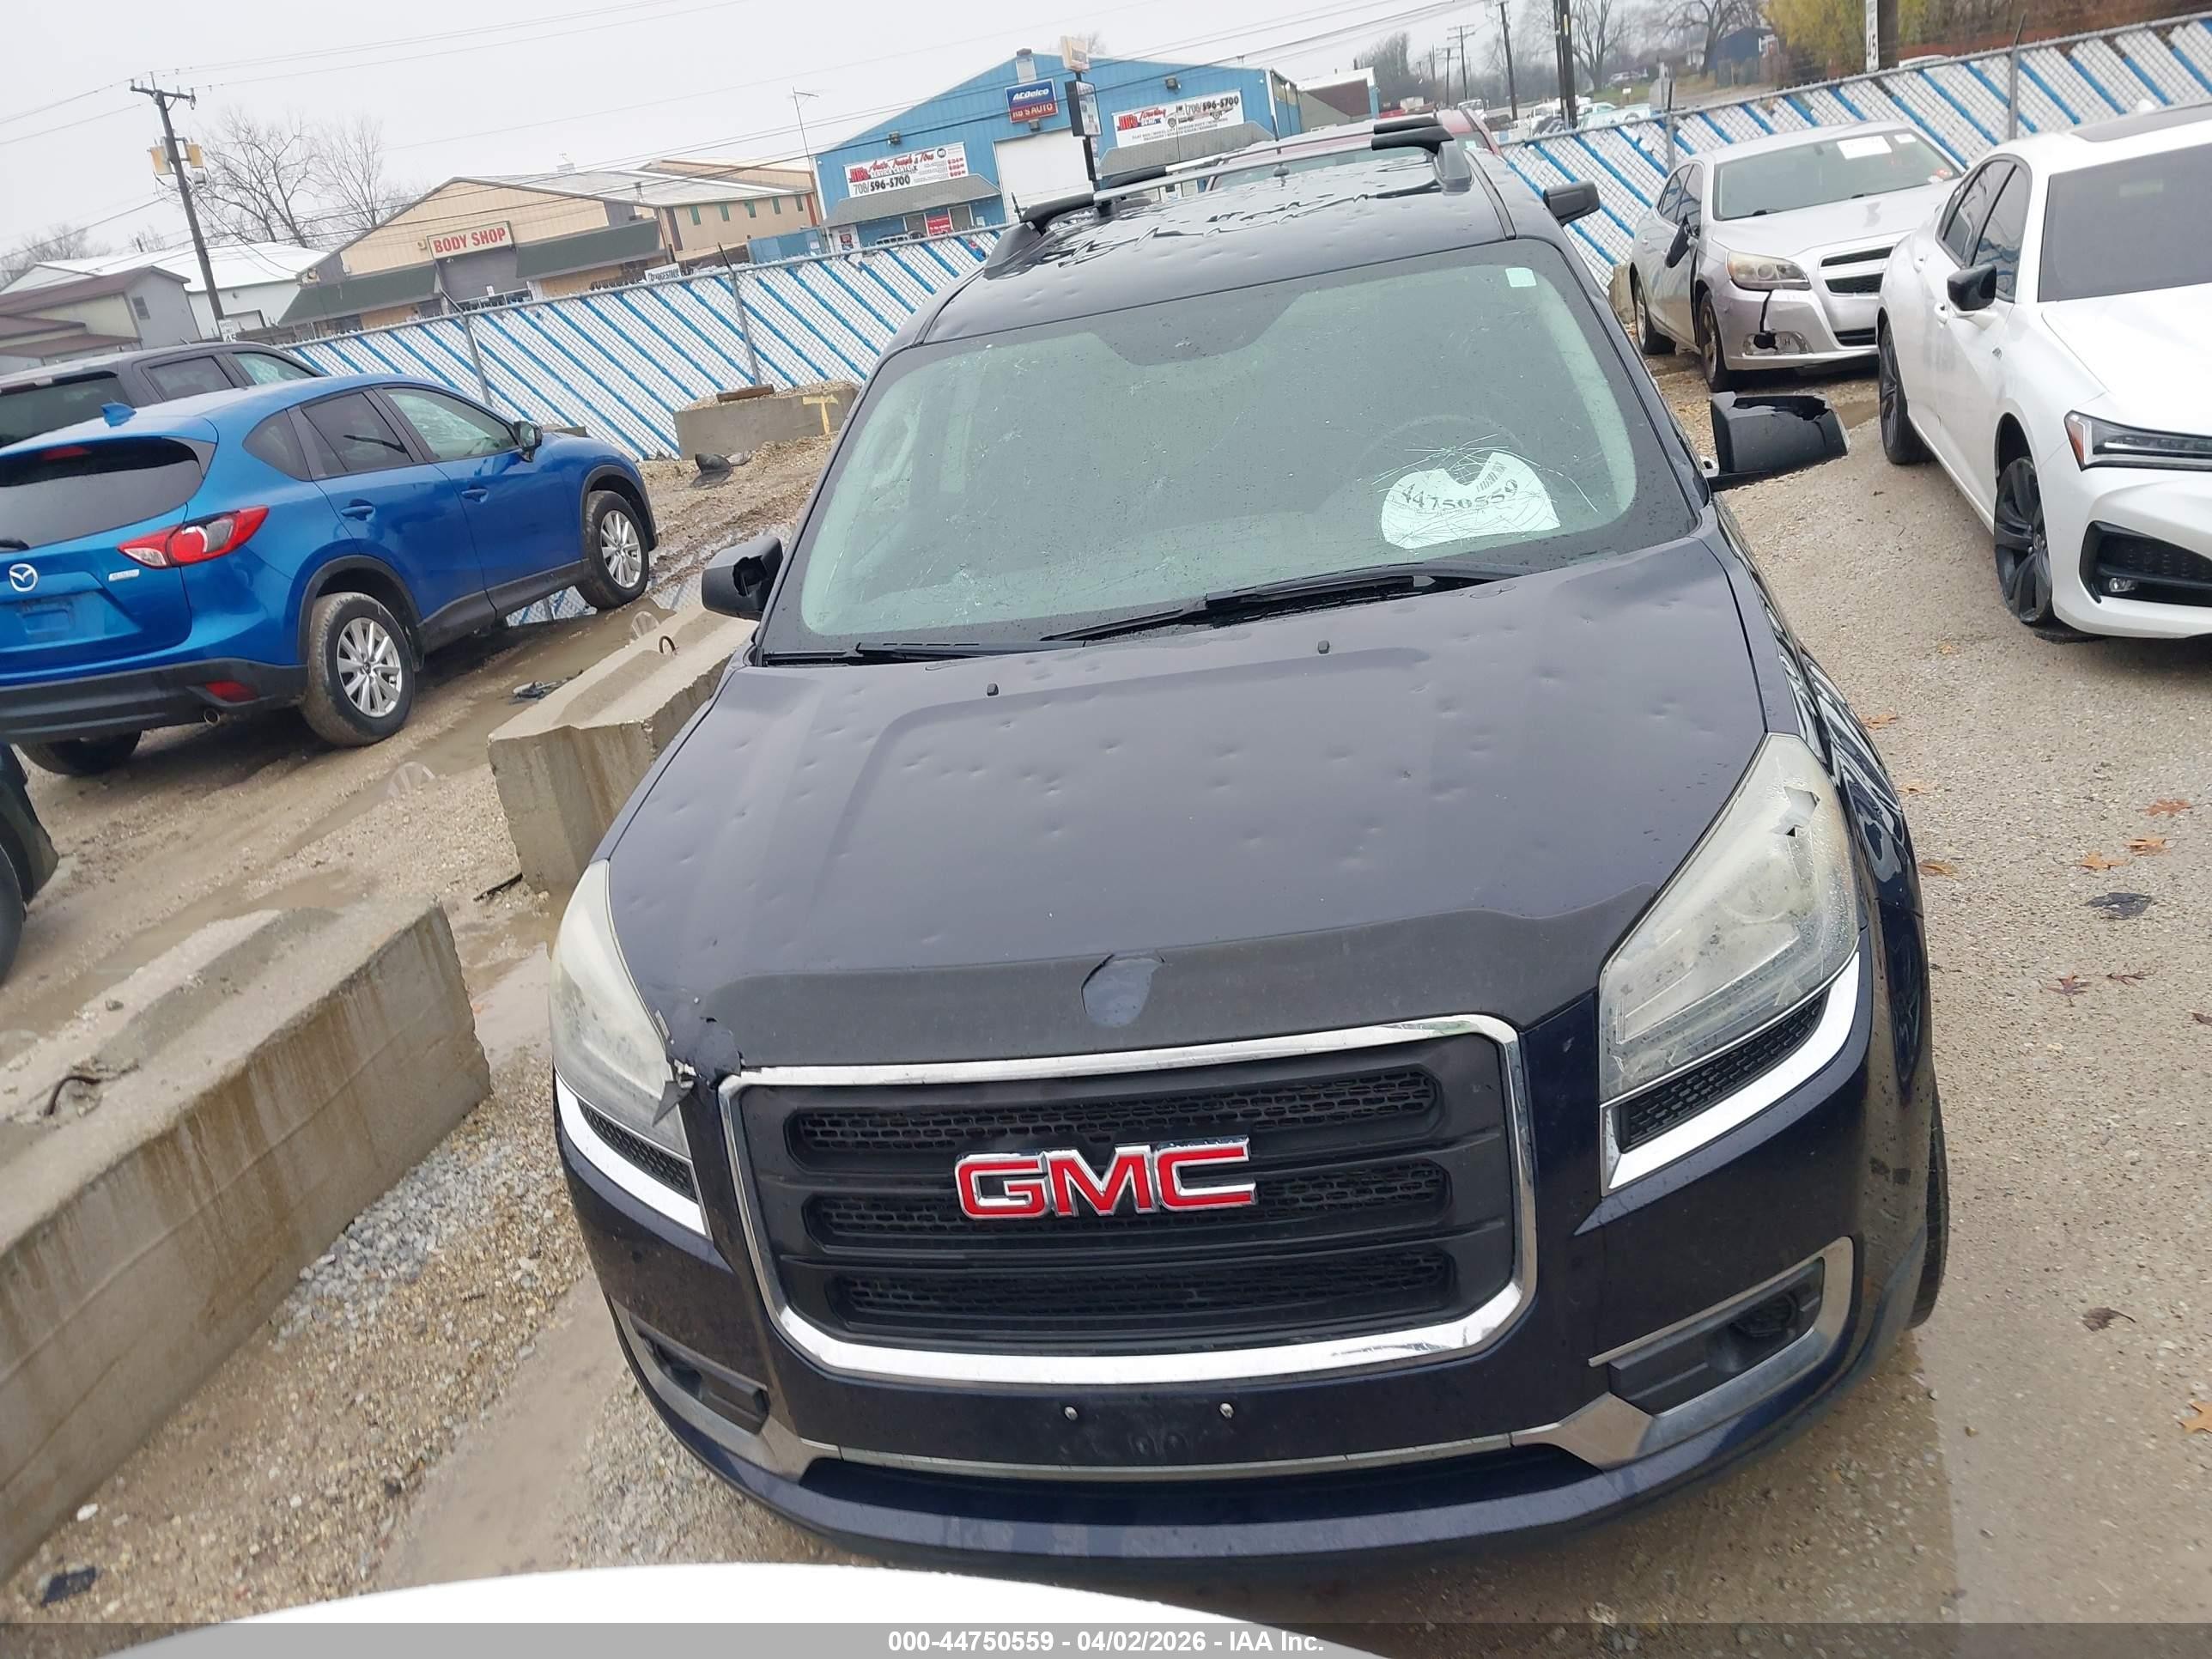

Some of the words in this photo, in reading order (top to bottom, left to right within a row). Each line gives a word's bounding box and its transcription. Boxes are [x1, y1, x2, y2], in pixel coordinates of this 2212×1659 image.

[1013, 88, 1049, 100] ACDelco
[853, 175, 910, 195] 708/596-5700
[433, 234, 467, 253] BODY
[471, 227, 506, 246] SHOP
[956, 1135, 1257, 1220] GMC
